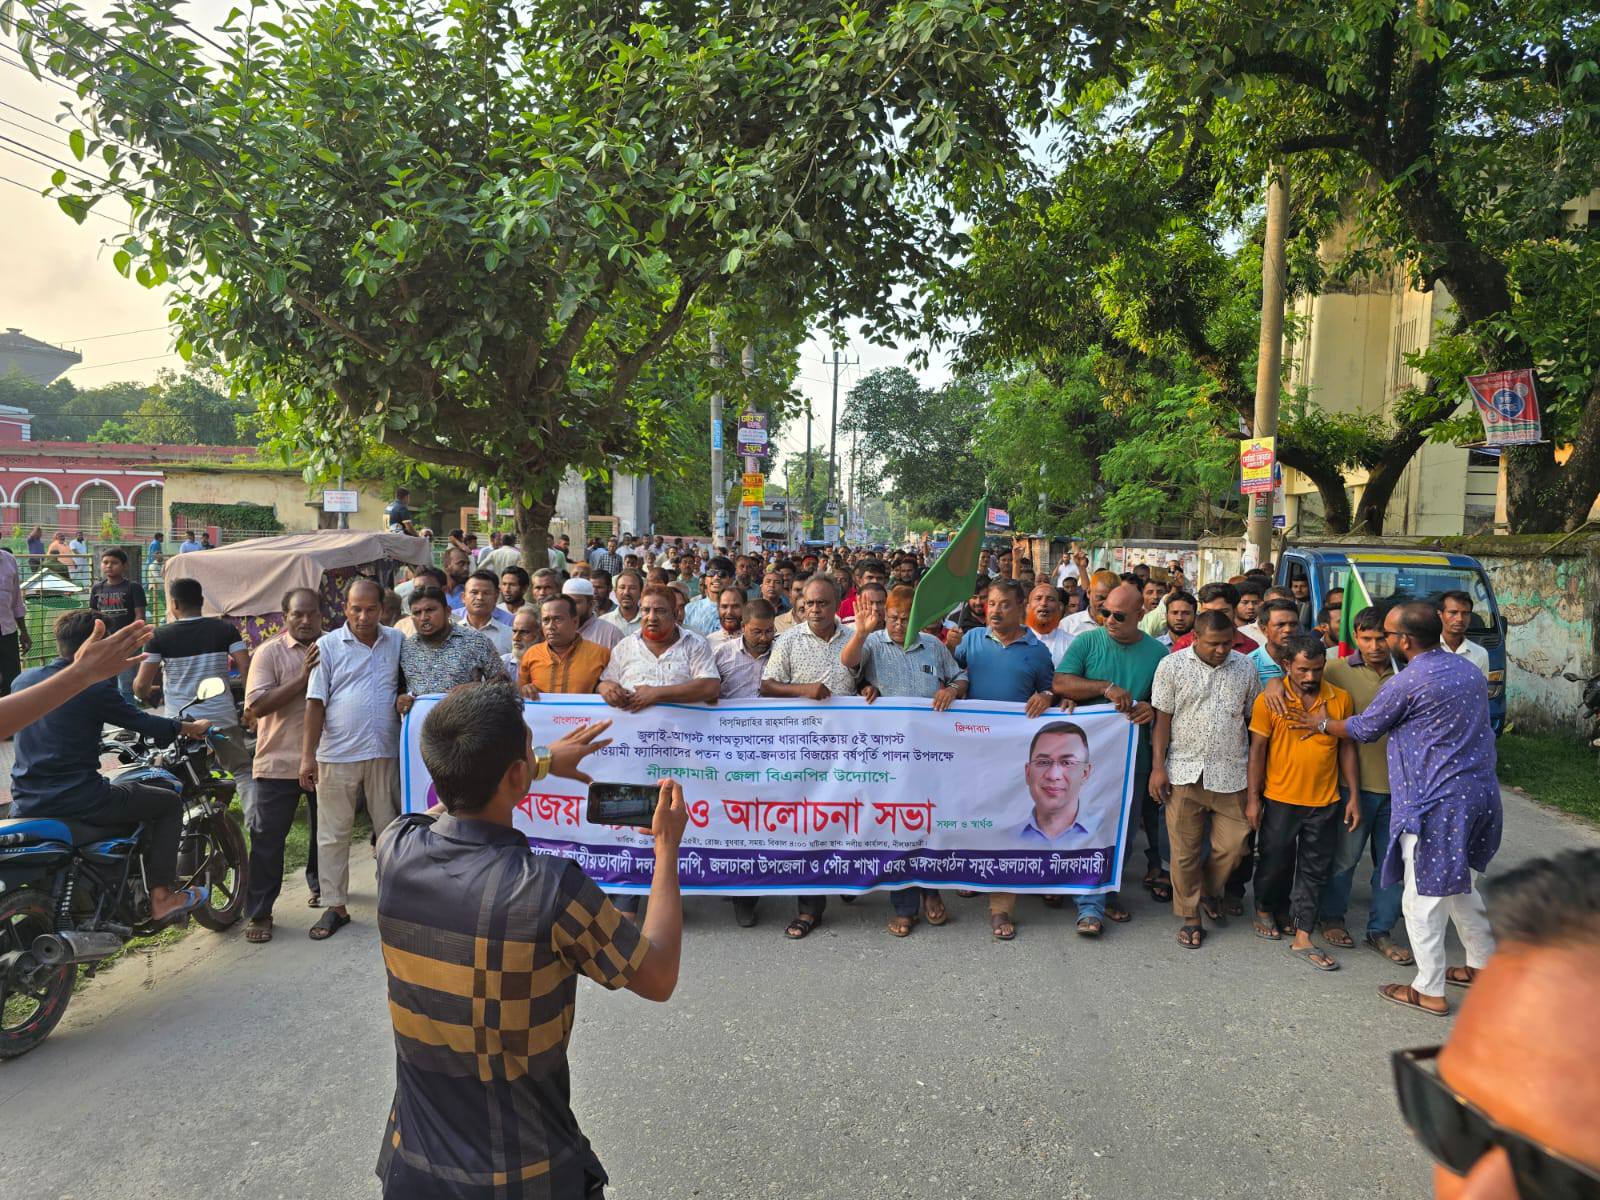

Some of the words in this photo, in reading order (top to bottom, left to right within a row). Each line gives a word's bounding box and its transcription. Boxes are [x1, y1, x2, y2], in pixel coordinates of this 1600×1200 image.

[552, 714, 592, 726] বাংলাদেশ
[955, 721, 990, 734] জিন্দাবাদ
[637, 728, 704, 744] জুলাই-আগস্ট
[779, 730, 848, 745] ধারাবাহিকতায়
[851, 731, 868, 745] ৫ই
[870, 732, 905, 745] আগস্ট
[634, 743, 691, 759] ফ্যাসিবাদের
[695, 749, 720, 761] পতন
[724, 751, 733, 760] ও
[736, 750, 797, 761] ছাত্র-জনতার
[800, 746, 840, 761] বিজয়ের
[842, 746, 880, 764] বর্ষপূর্তি
[882, 750, 910, 761] পালন
[913, 748, 955, 762] উপলক্ষে
[646, 763, 719, 781] নীলফামারী
[724, 769, 760, 783] জেলা
[766, 767, 829, 783] বিএনপির
[833, 768, 896, 784] উদ্যোগে-
[685, 799, 709, 828] ও
[720, 796, 864, 834] আলোচনা
[872, 797, 936, 835] সভা
[937, 818, 957, 830] সফল
[961, 820, 968, 829] ও
[709, 856, 754, 875] জলঢাকা
[758, 853, 806, 875] উপজেলা
[809, 862, 819, 874] ও
[823, 853, 850, 876] পৌর
[853, 856, 880, 876] শাখা
[883, 859, 906, 875] এবং
[909, 852, 966, 874] অঙ্গসংগঠন
